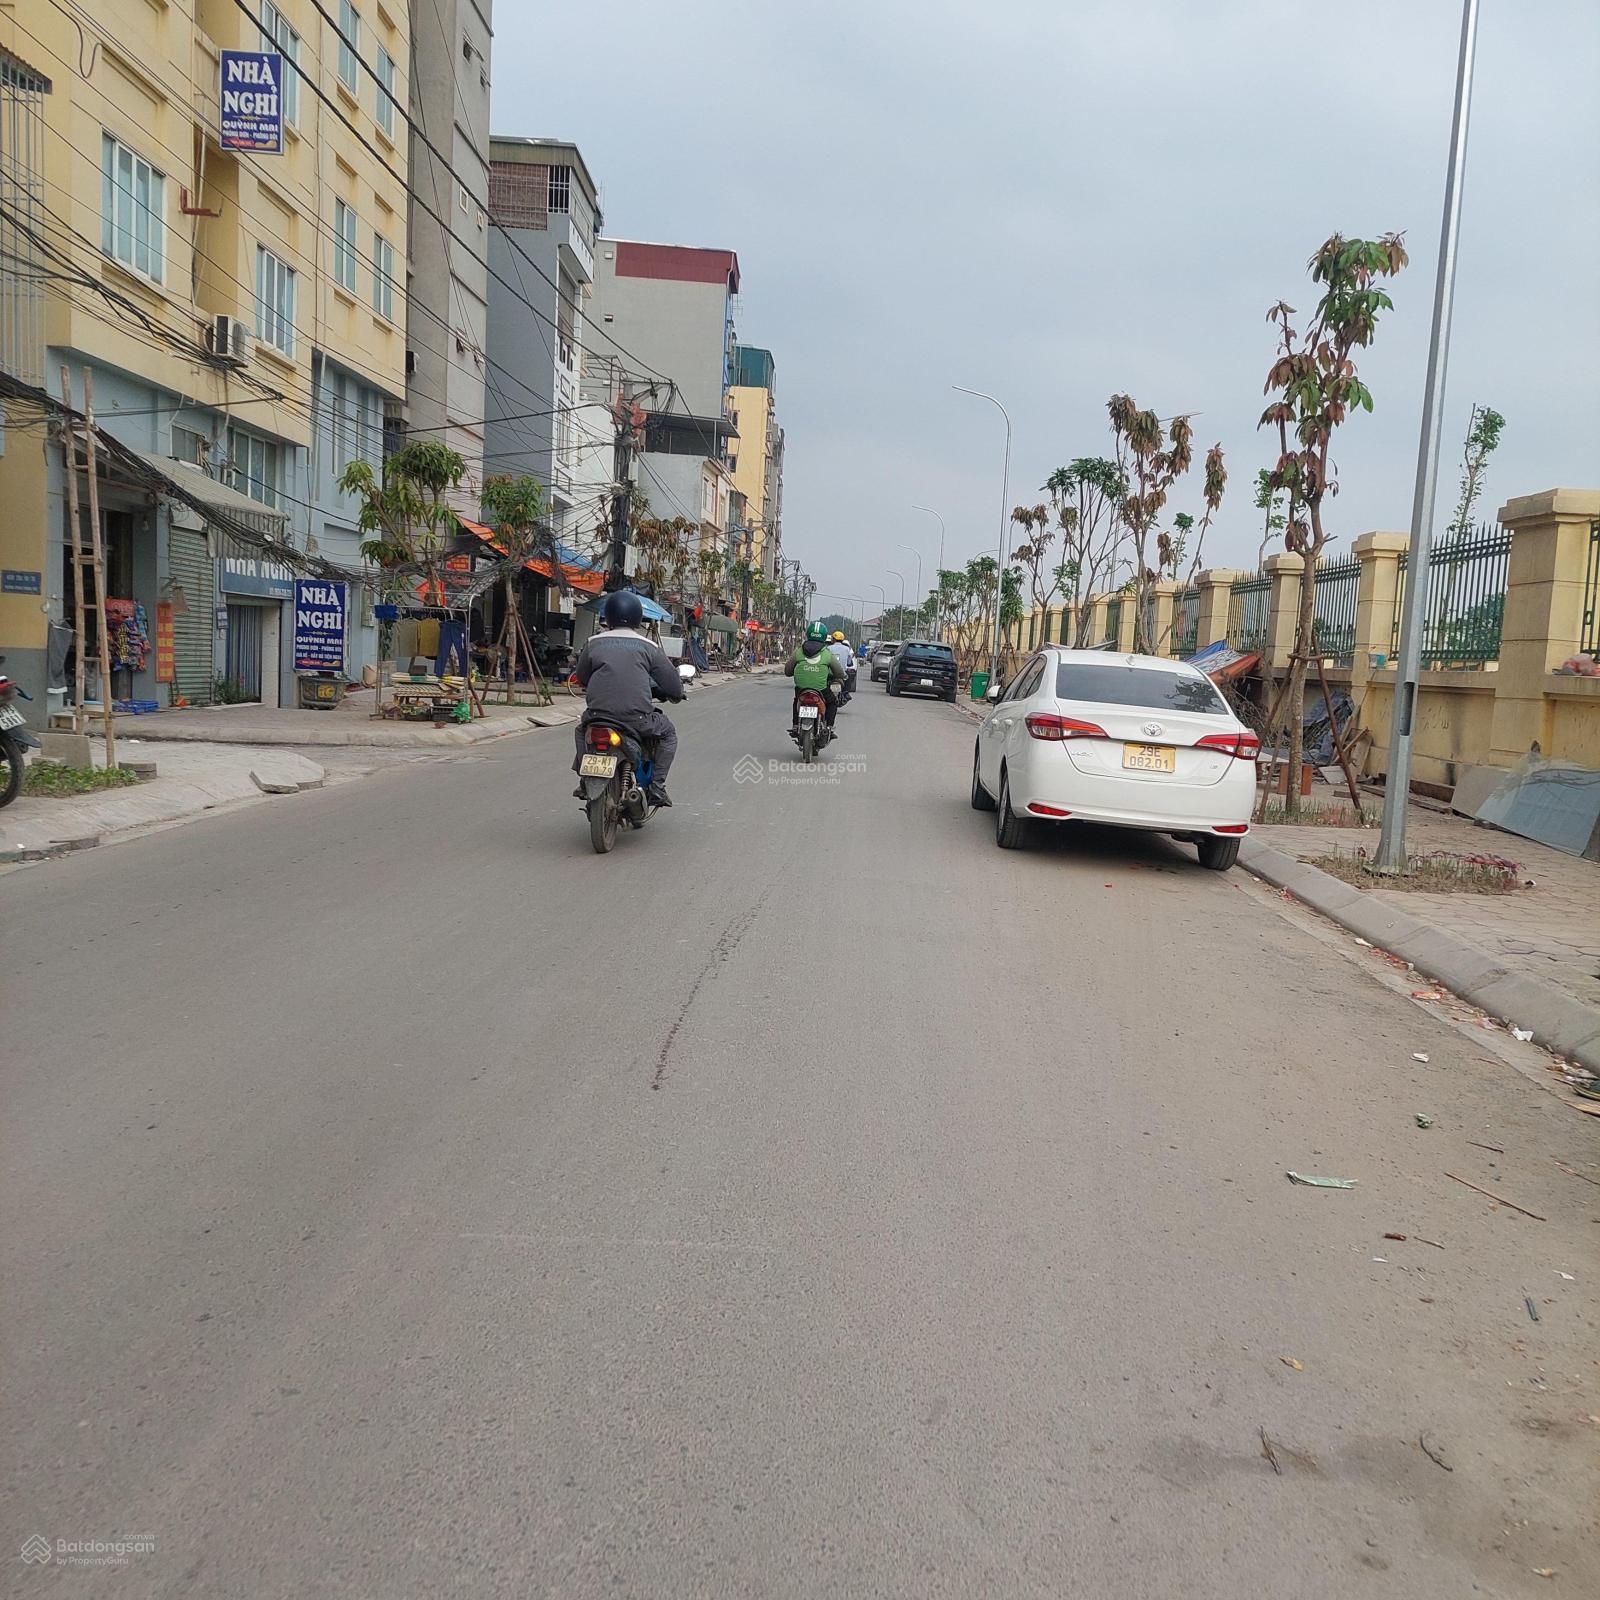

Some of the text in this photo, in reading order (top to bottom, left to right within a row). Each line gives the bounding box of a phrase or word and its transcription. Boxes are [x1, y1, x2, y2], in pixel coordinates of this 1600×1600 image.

[227, 56, 275, 85] NHÀ
[223, 85, 278, 116] NGHỈ
[301, 584, 340, 606] NHÀ
[297, 606, 342, 630] NGHỈ
[803, 665, 820, 673] Grab
[1138, 745, 1161, 757] 29E
[1129, 756, 1169, 769] 082.01
